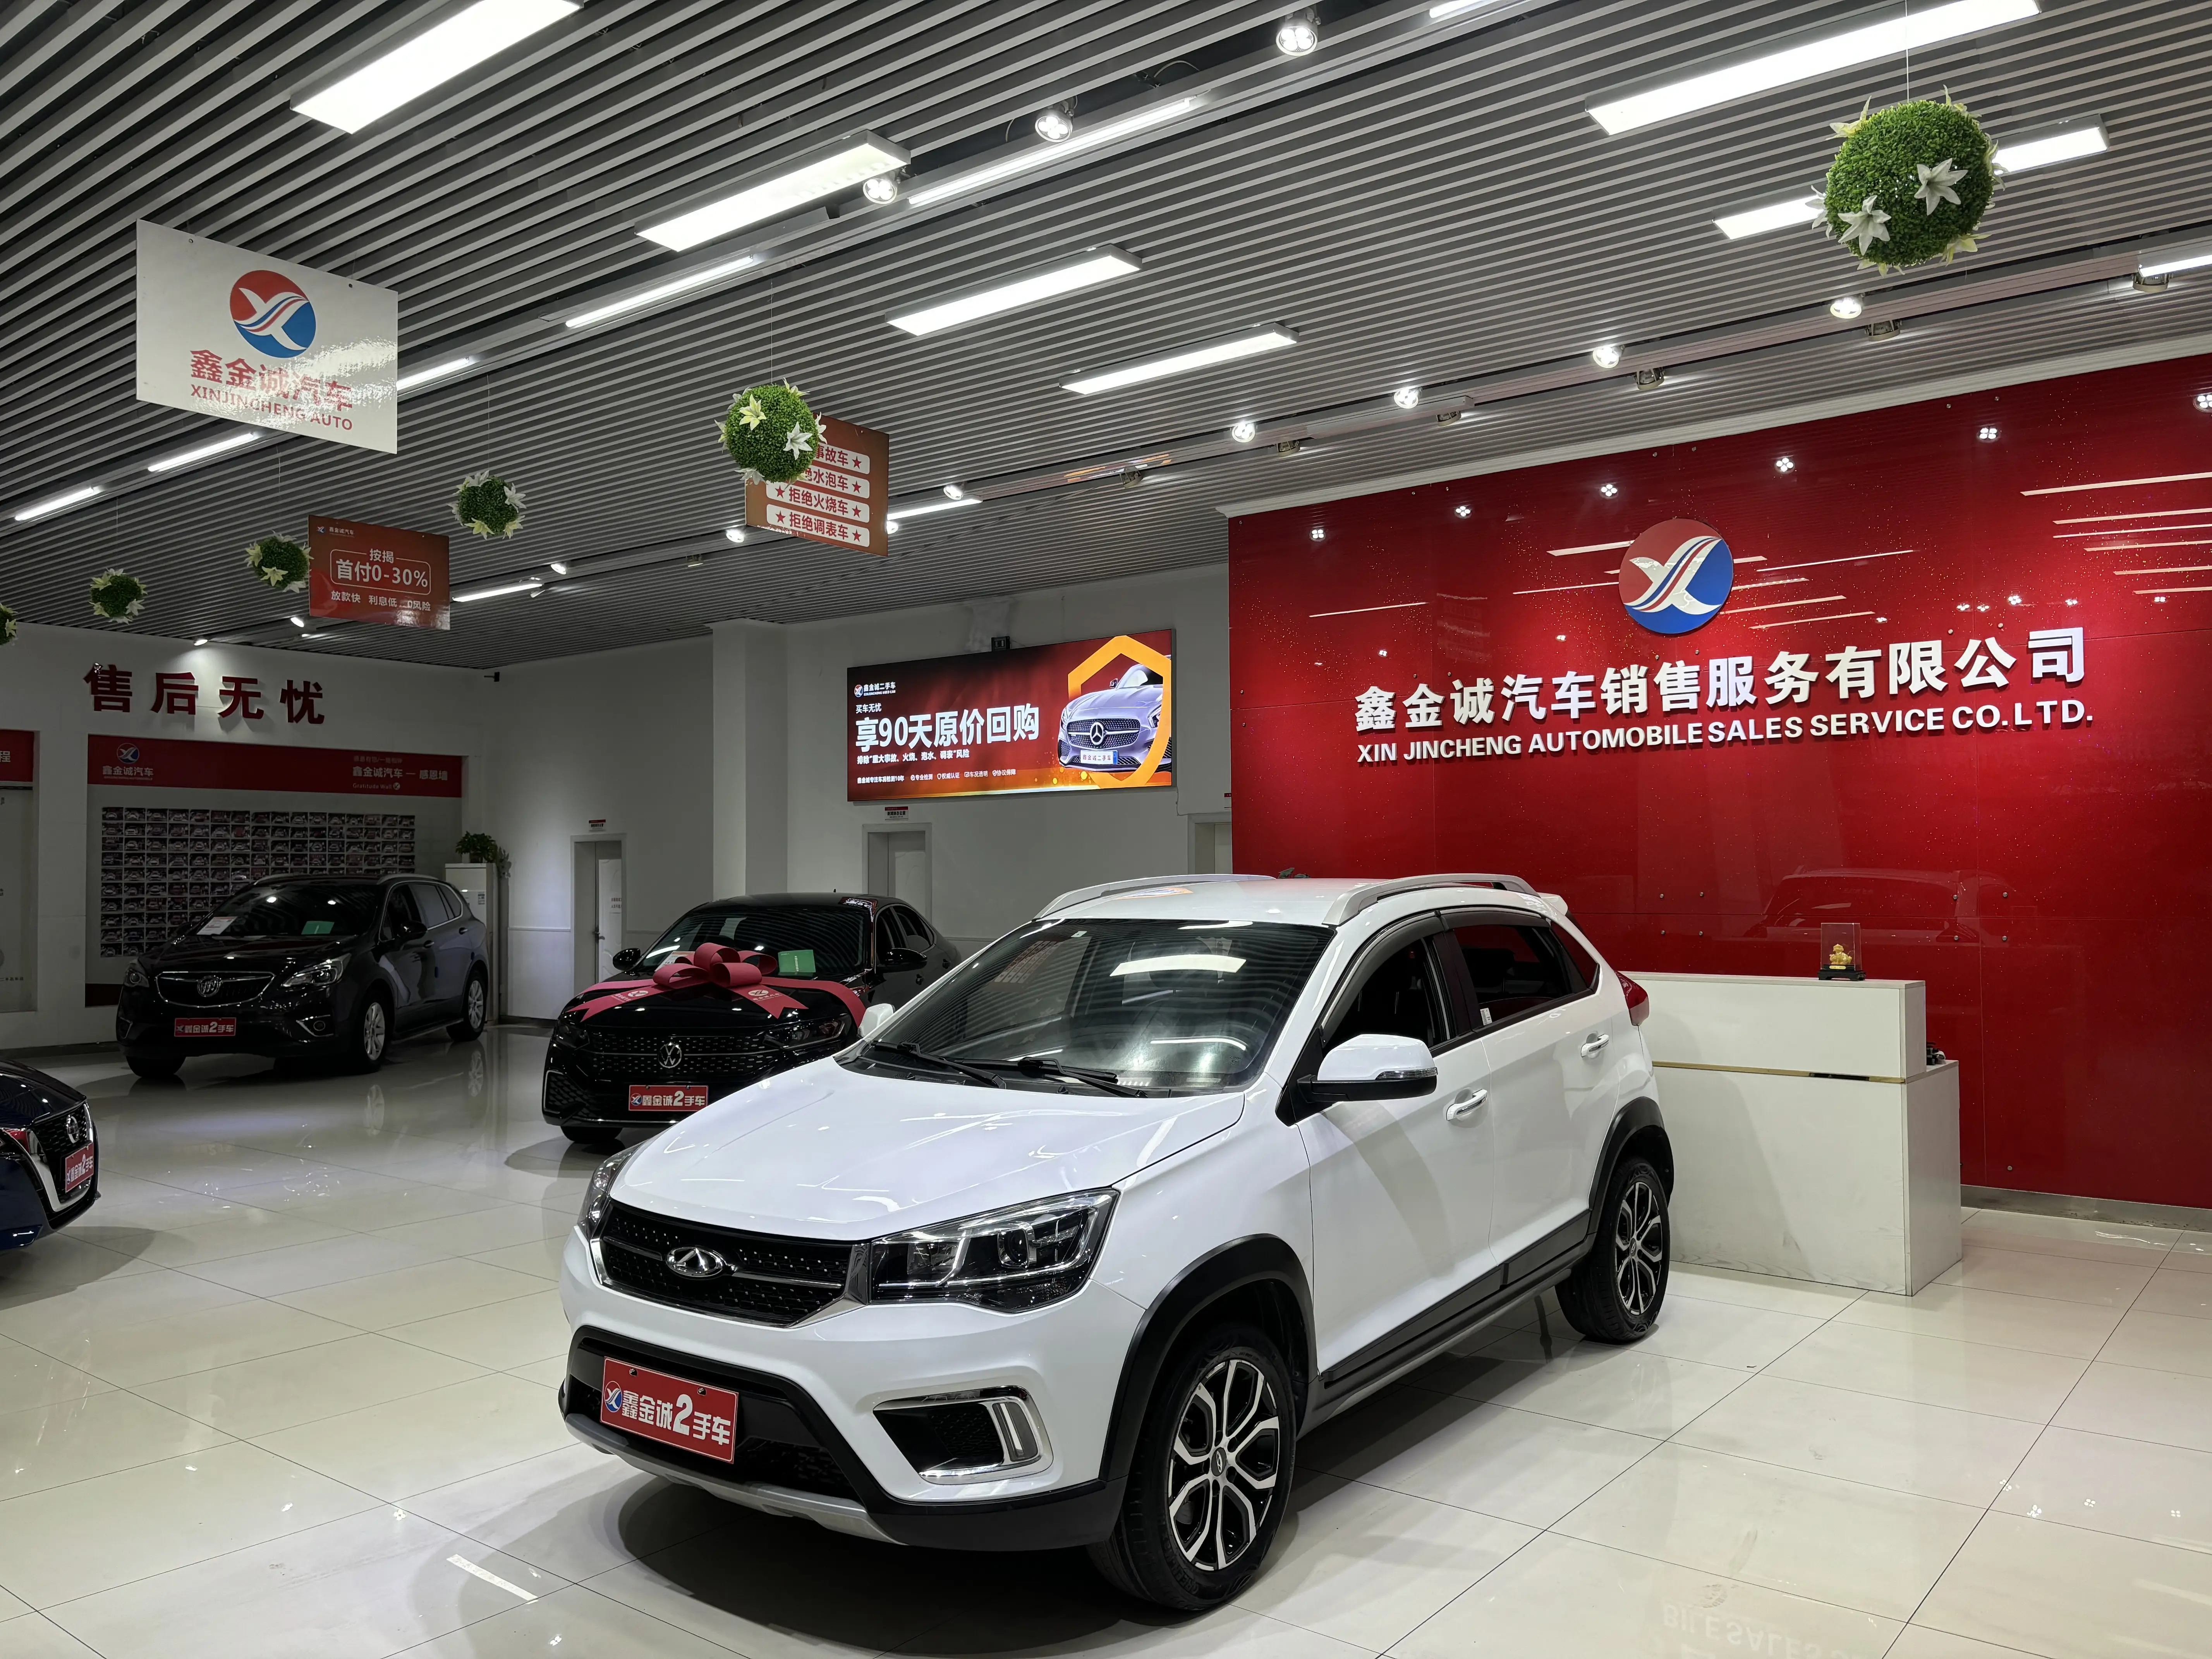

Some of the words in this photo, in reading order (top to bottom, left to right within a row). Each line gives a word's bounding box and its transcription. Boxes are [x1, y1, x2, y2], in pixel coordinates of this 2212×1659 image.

[190, 349, 353, 411] 鑫金诚汽车
[191, 384, 306, 420] XINJINCHENG
[310, 413, 353, 431] AUTO
[789, 486, 848, 516] 拒绝火烧车
[789, 512, 848, 540] 拒绝调表车
[369, 548, 394, 563] 按揭
[336, 558, 428, 587] 首付0-30%
[331, 590, 361, 603] 放款快
[368, 595, 397, 608] 利息低
[407, 600, 431, 611] 0风险
[1354, 626, 2086, 732] 鑫金诚汽车销售服务有限公司
[82, 663, 325, 725] 售后无忧
[855, 702, 882, 714] 买车无忧
[855, 703, 1039, 752] 享90天原价回购
[1357, 742, 1397, 763] XIN
[1403, 735, 1522, 761] JINCHENG
[1528, 722, 1703, 753] AUTOMOBILE
[1708, 716, 1803, 742] SALES
[1810, 707, 1945, 737] SERVICE
[103, 765, 154, 776] 鑫金诚汽车
[184, 1021, 234, 1033] 鑫金诚2手车
[642, 1090, 705, 1106] 鑫金诚2手车
[621, 1390, 731, 1446] 鑫金诚2手车
